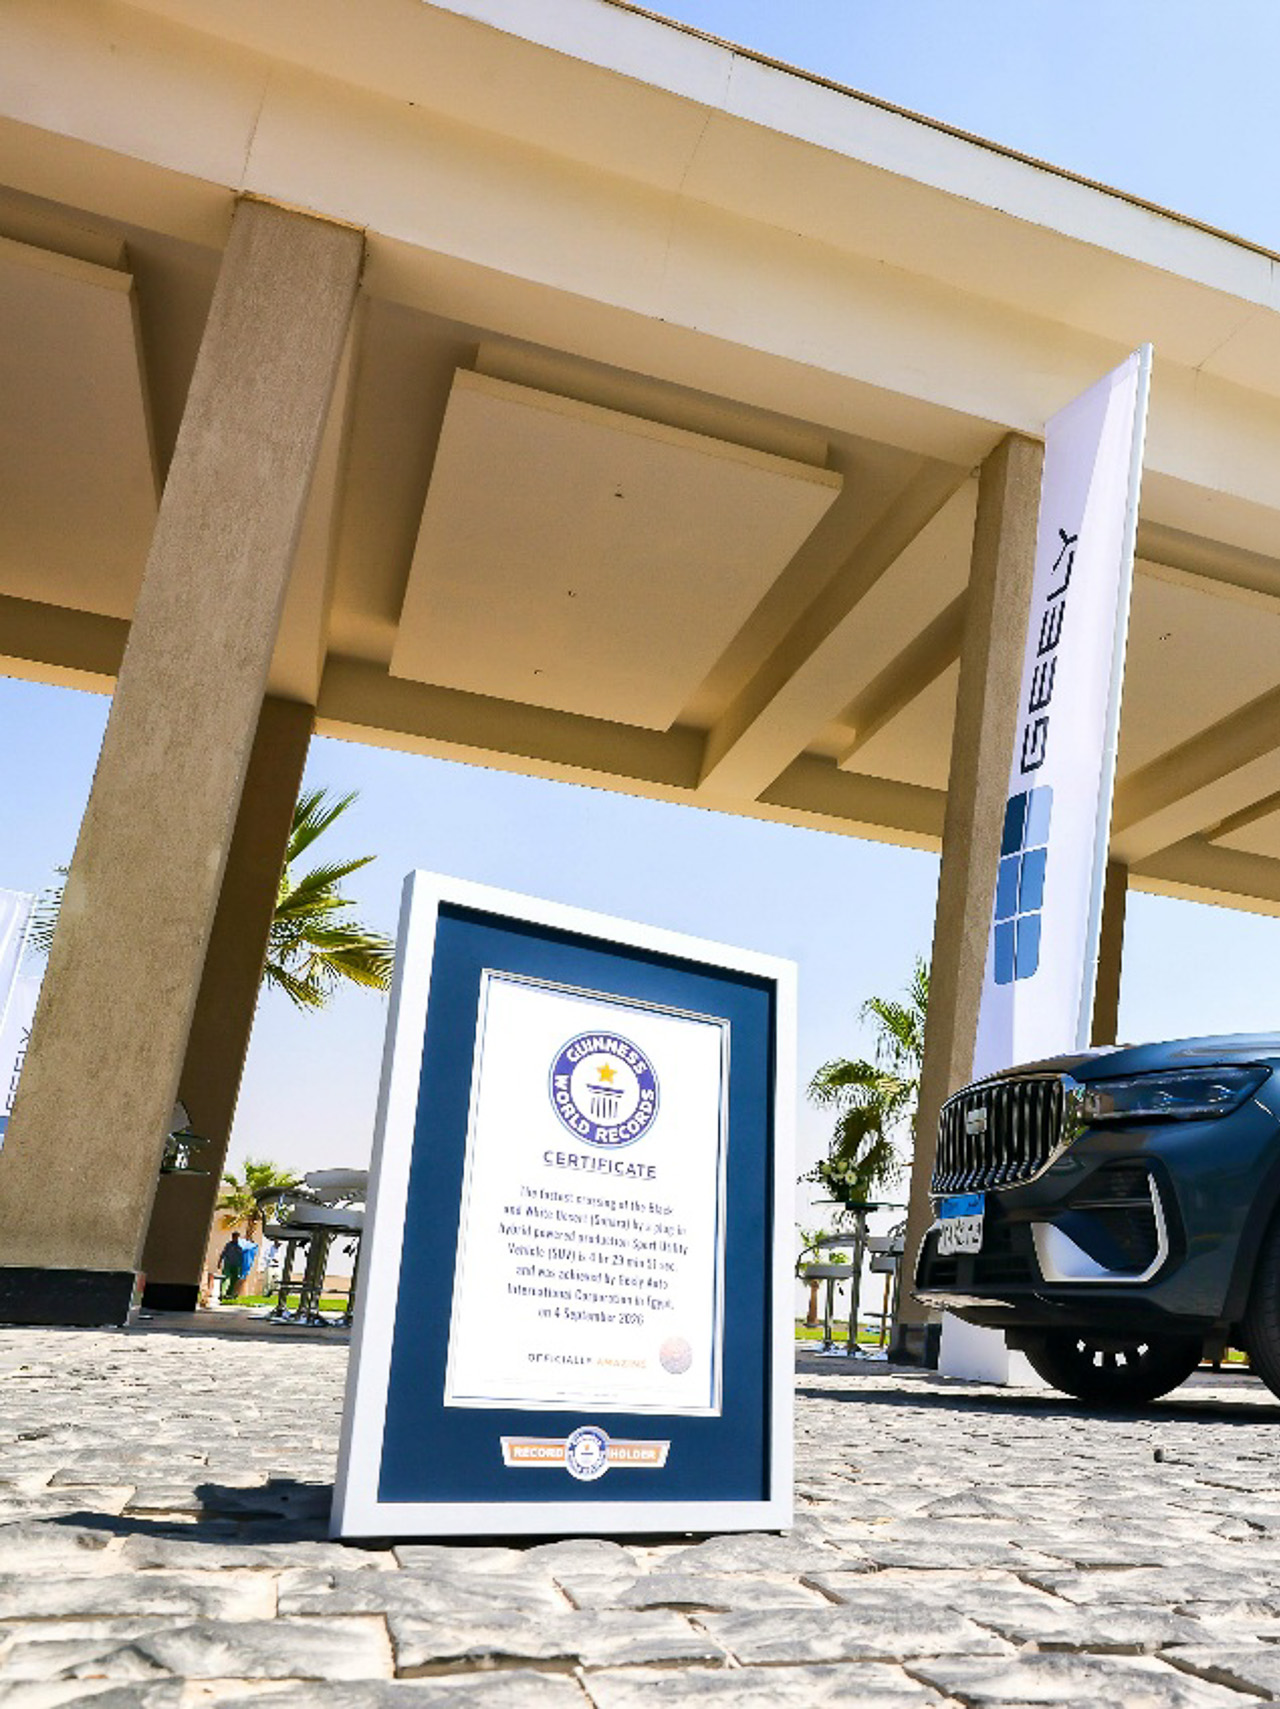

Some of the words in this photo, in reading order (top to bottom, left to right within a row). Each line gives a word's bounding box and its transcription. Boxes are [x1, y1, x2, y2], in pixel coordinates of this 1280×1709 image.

[1020, 528, 1078, 774] GEELY
[565, 1036, 649, 1076] GUINNESS
[554, 1074, 590, 1135] WORLD
[595, 1088, 655, 1143] RECORDS
[543, 1150, 657, 1179] CERTIFICATE
[513, 1446, 565, 1459] RECORD
[610, 1447, 658, 1461] HOLDER
